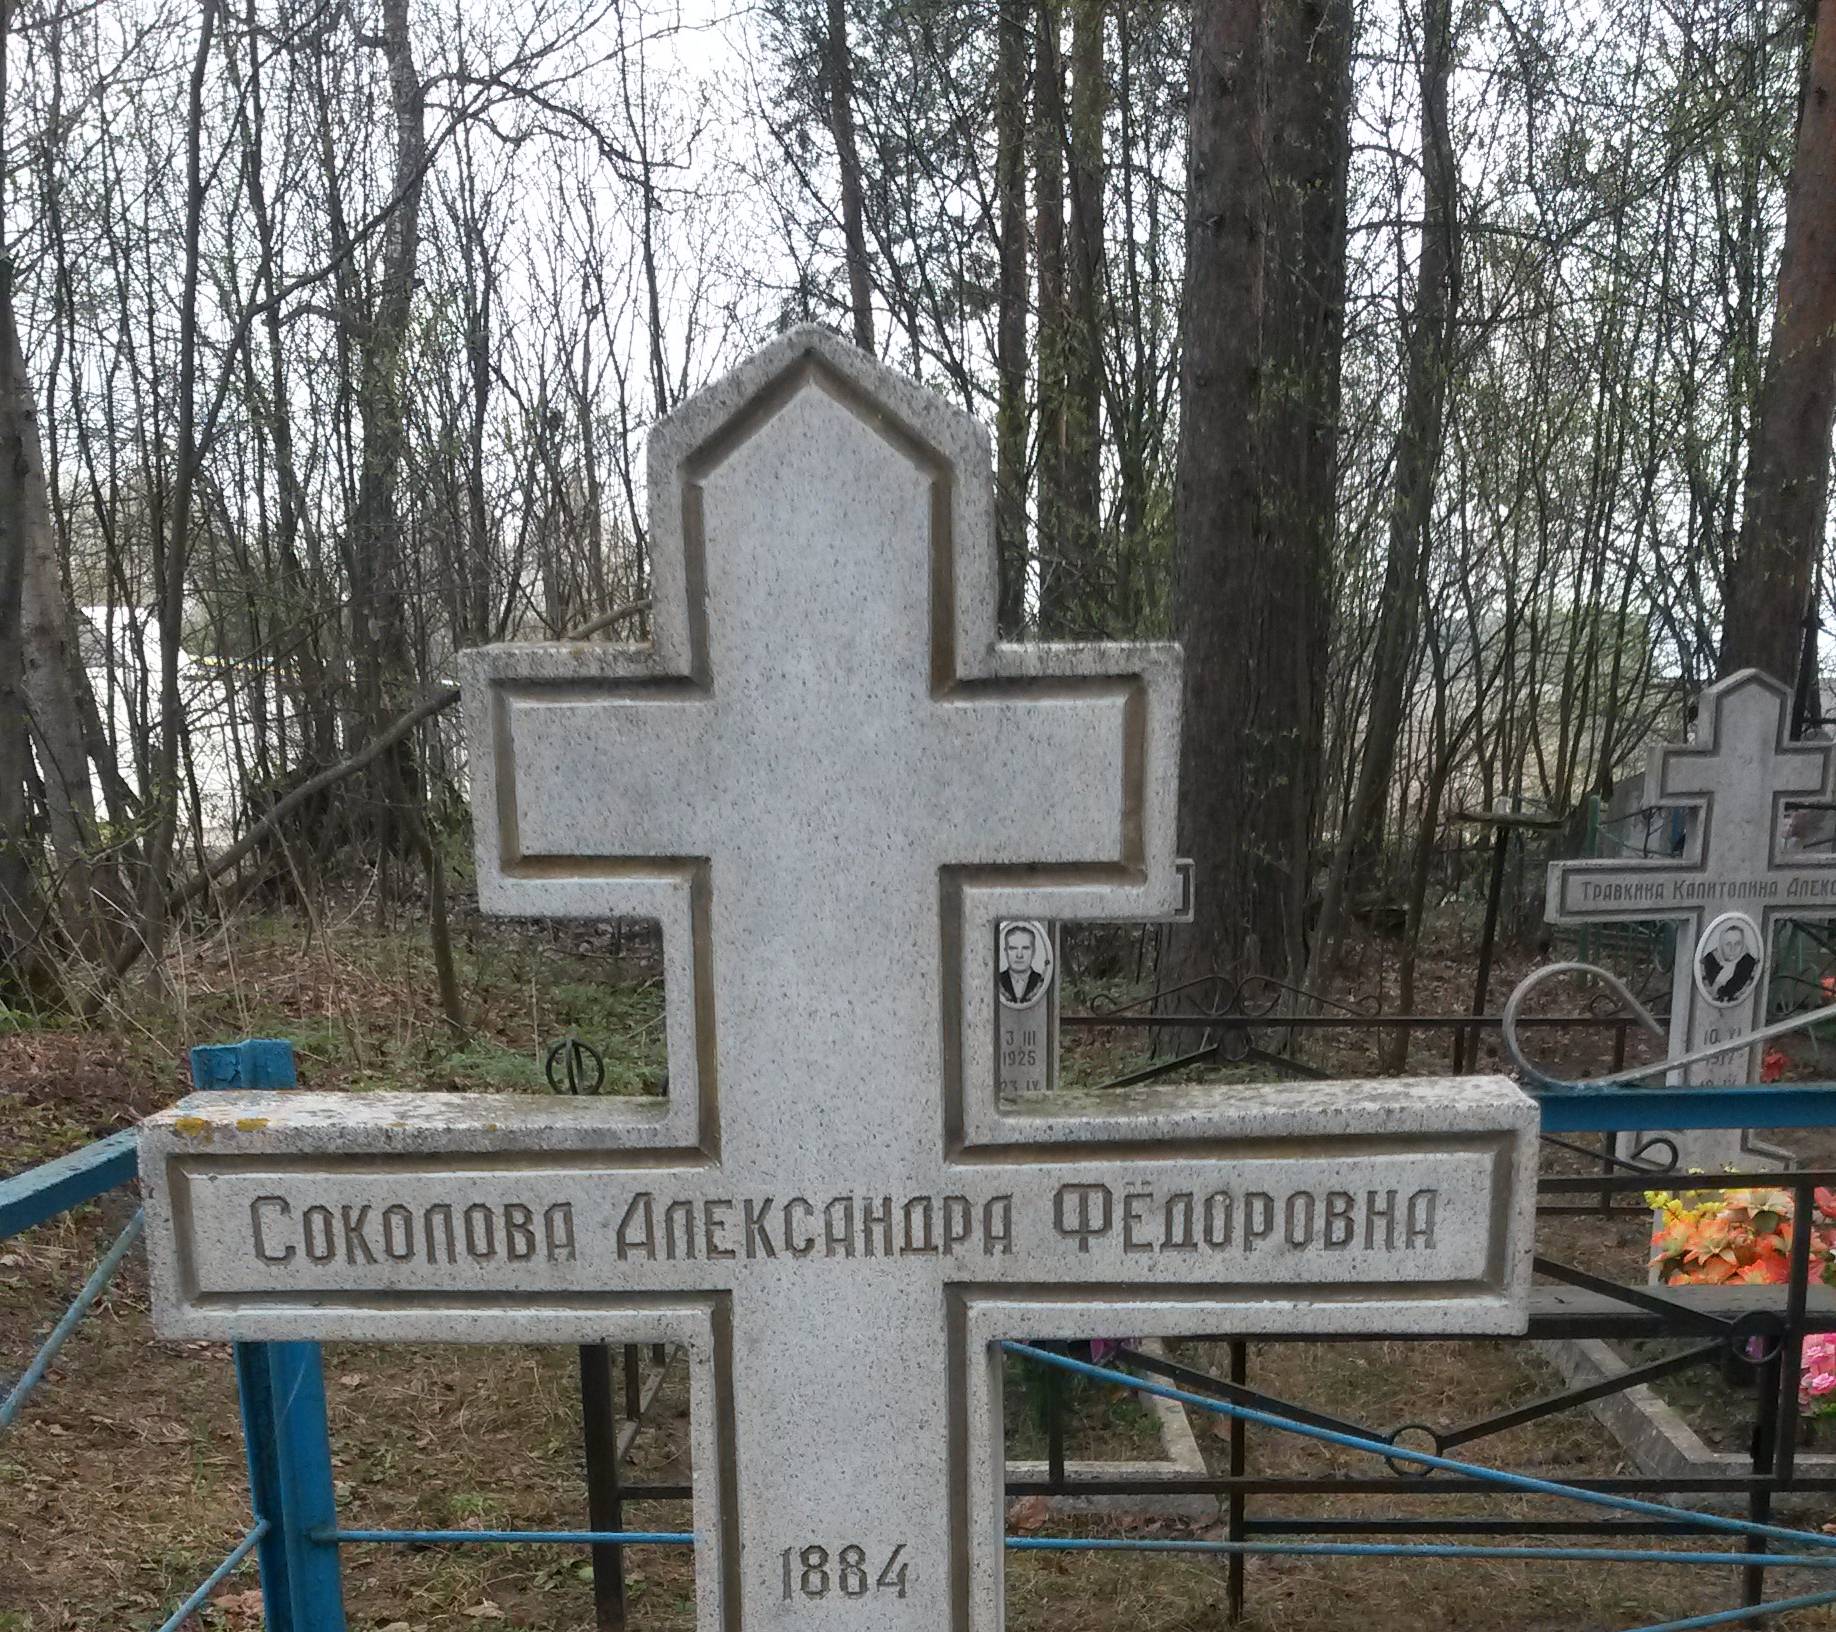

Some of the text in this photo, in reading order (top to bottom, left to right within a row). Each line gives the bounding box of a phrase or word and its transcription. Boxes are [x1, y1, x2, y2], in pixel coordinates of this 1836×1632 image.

[1006, 1030, 1036, 1046] 3 III
[1003, 1050, 1036, 1067] 1925
[250, 1181, 1439, 1266] СОКОЛОВА АЛЕКСАНДРА ФЁДОРОВНА
[779, 1543, 908, 1602] 1884
